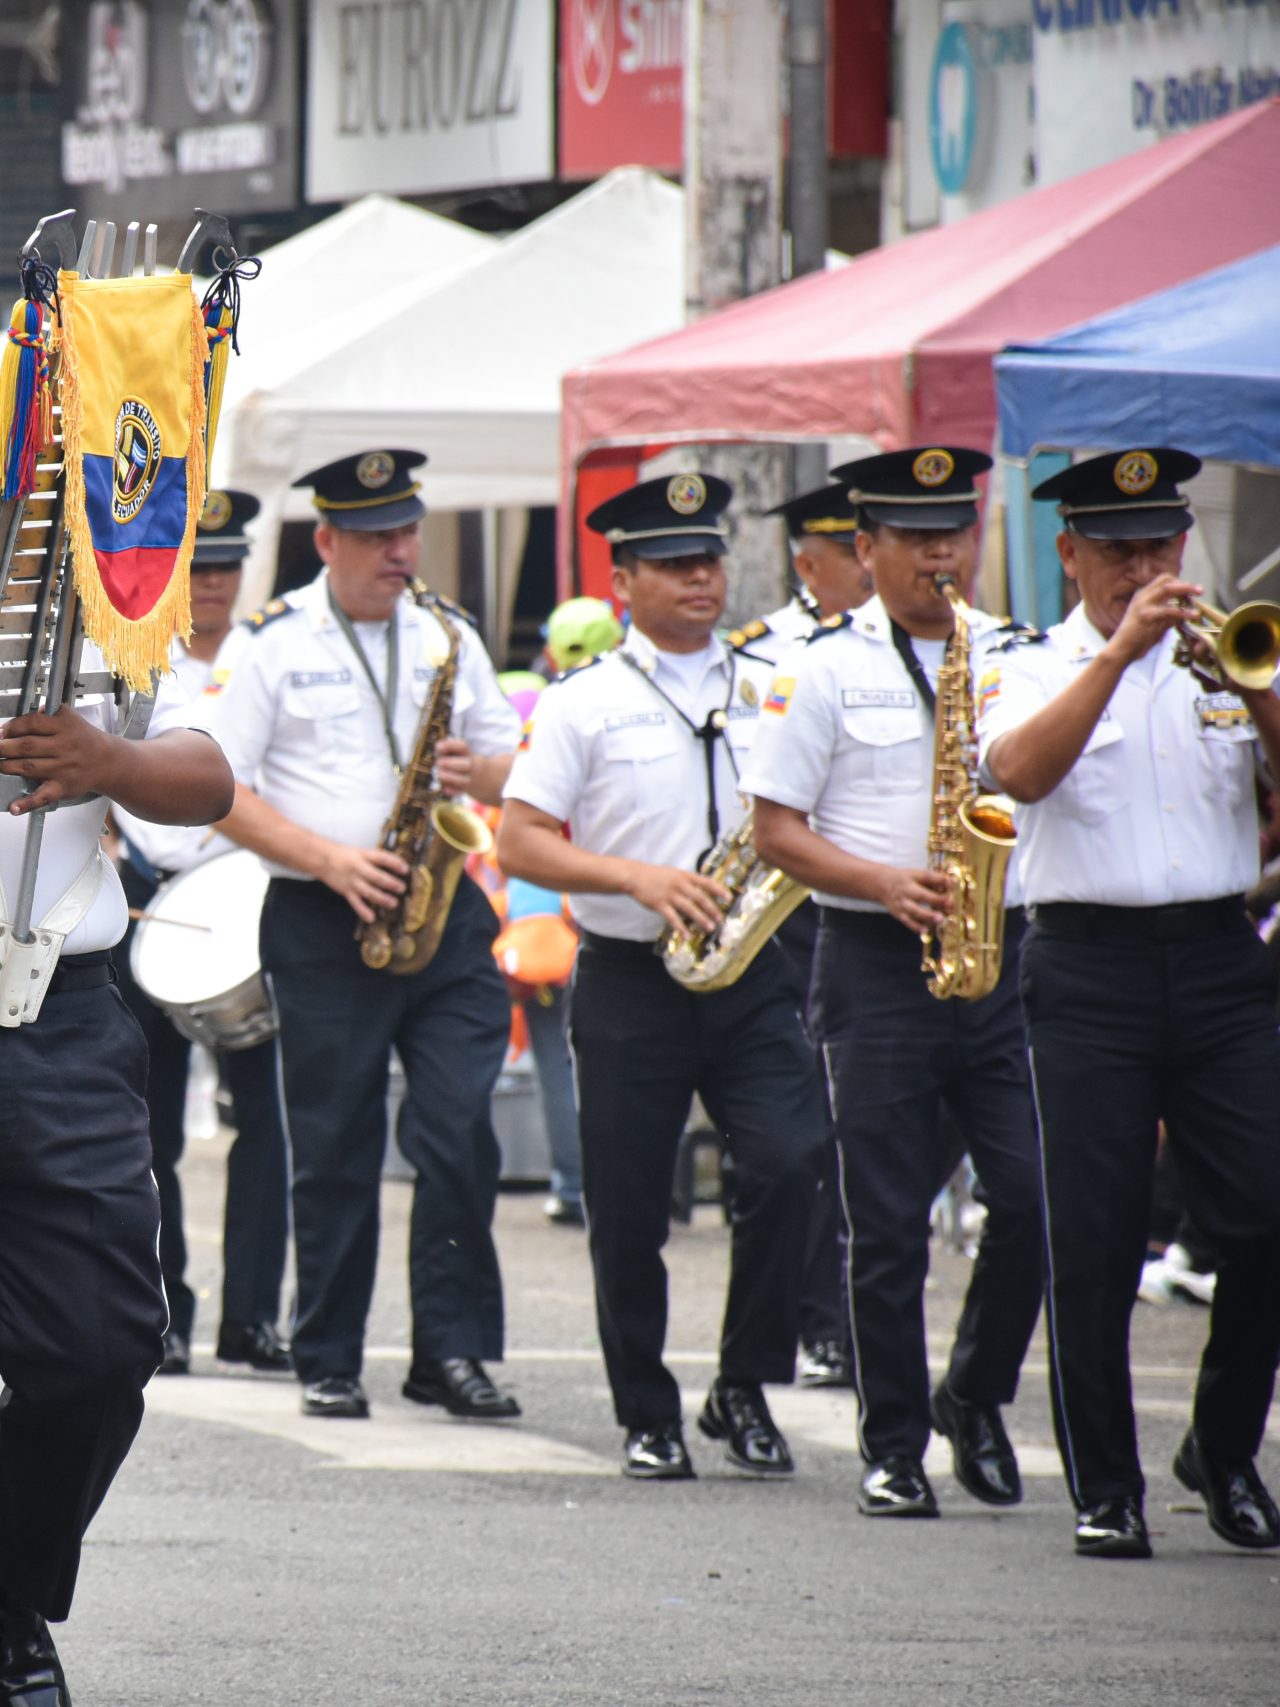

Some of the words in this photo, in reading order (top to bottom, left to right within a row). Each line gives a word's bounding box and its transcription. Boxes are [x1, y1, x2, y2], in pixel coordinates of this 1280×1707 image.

[336, 0, 521, 139] EUROZZ
[124, 402, 136, 416] DE
[137, 404, 161, 460] TRANSITO
[117, 479, 151, 518] ECUADOR
